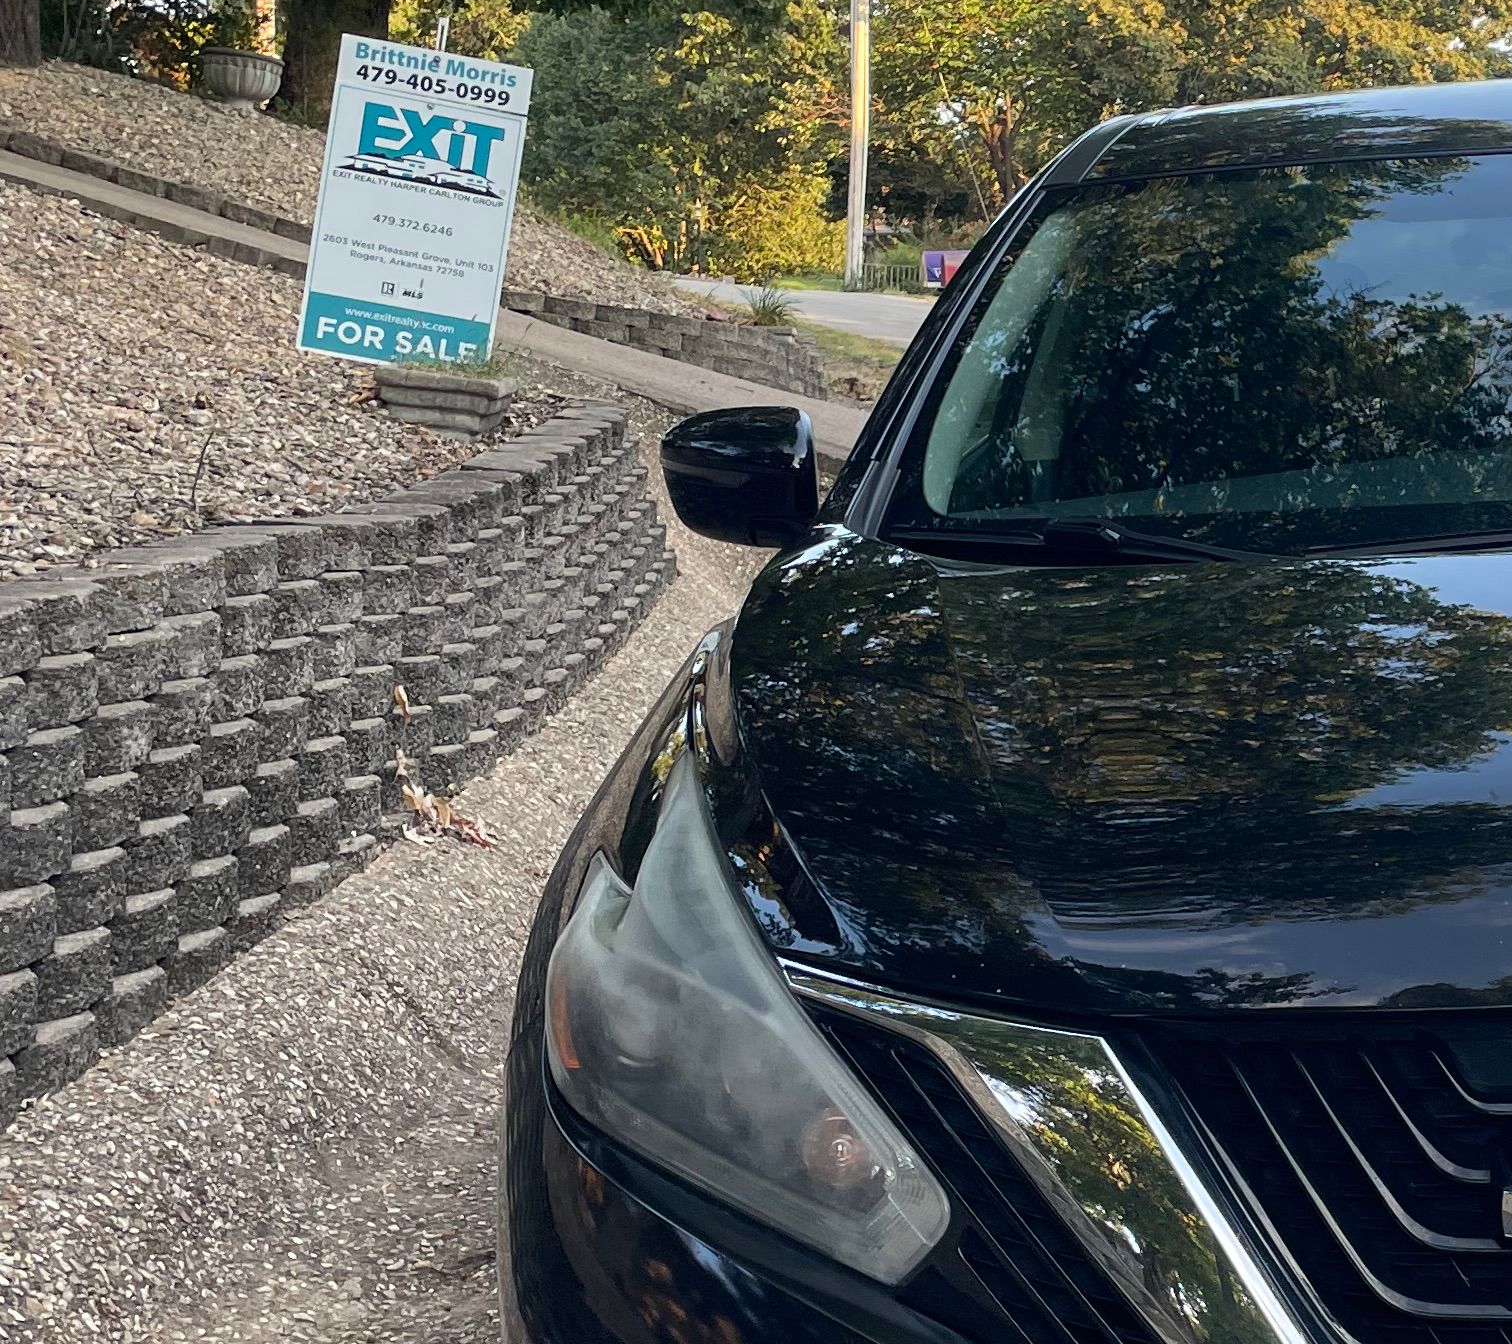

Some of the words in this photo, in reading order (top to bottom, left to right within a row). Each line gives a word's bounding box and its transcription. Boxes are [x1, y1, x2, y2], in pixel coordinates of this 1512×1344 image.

[355, 42, 440, 73] Brittnie
[445, 59, 517, 88] Morris
[356, 64, 510, 106] 479-405-0999
[332, 169, 352, 179] EXIT
[354, 173, 388, 187] REALTY
[391, 181, 427, 194] HARPER
[428, 188, 471, 202] CARLTON
[472, 196, 504, 208] GROUP
[372, 213, 454, 237] 479.372.6246
[349, 249, 386, 265] Rogers,
[389, 257, 433, 273] Arkansas
[435, 265, 465, 278] 72758
[351, 239, 375, 251] West
[378, 243, 419, 260] Pleasant
[421, 252, 453, 266] Grove,
[455, 258, 475, 270] Unit
[478, 261, 494, 273] 103
[402, 287, 424, 300] MLS
[316, 315, 385, 351] FOR
[394, 330, 478, 364] SALE
